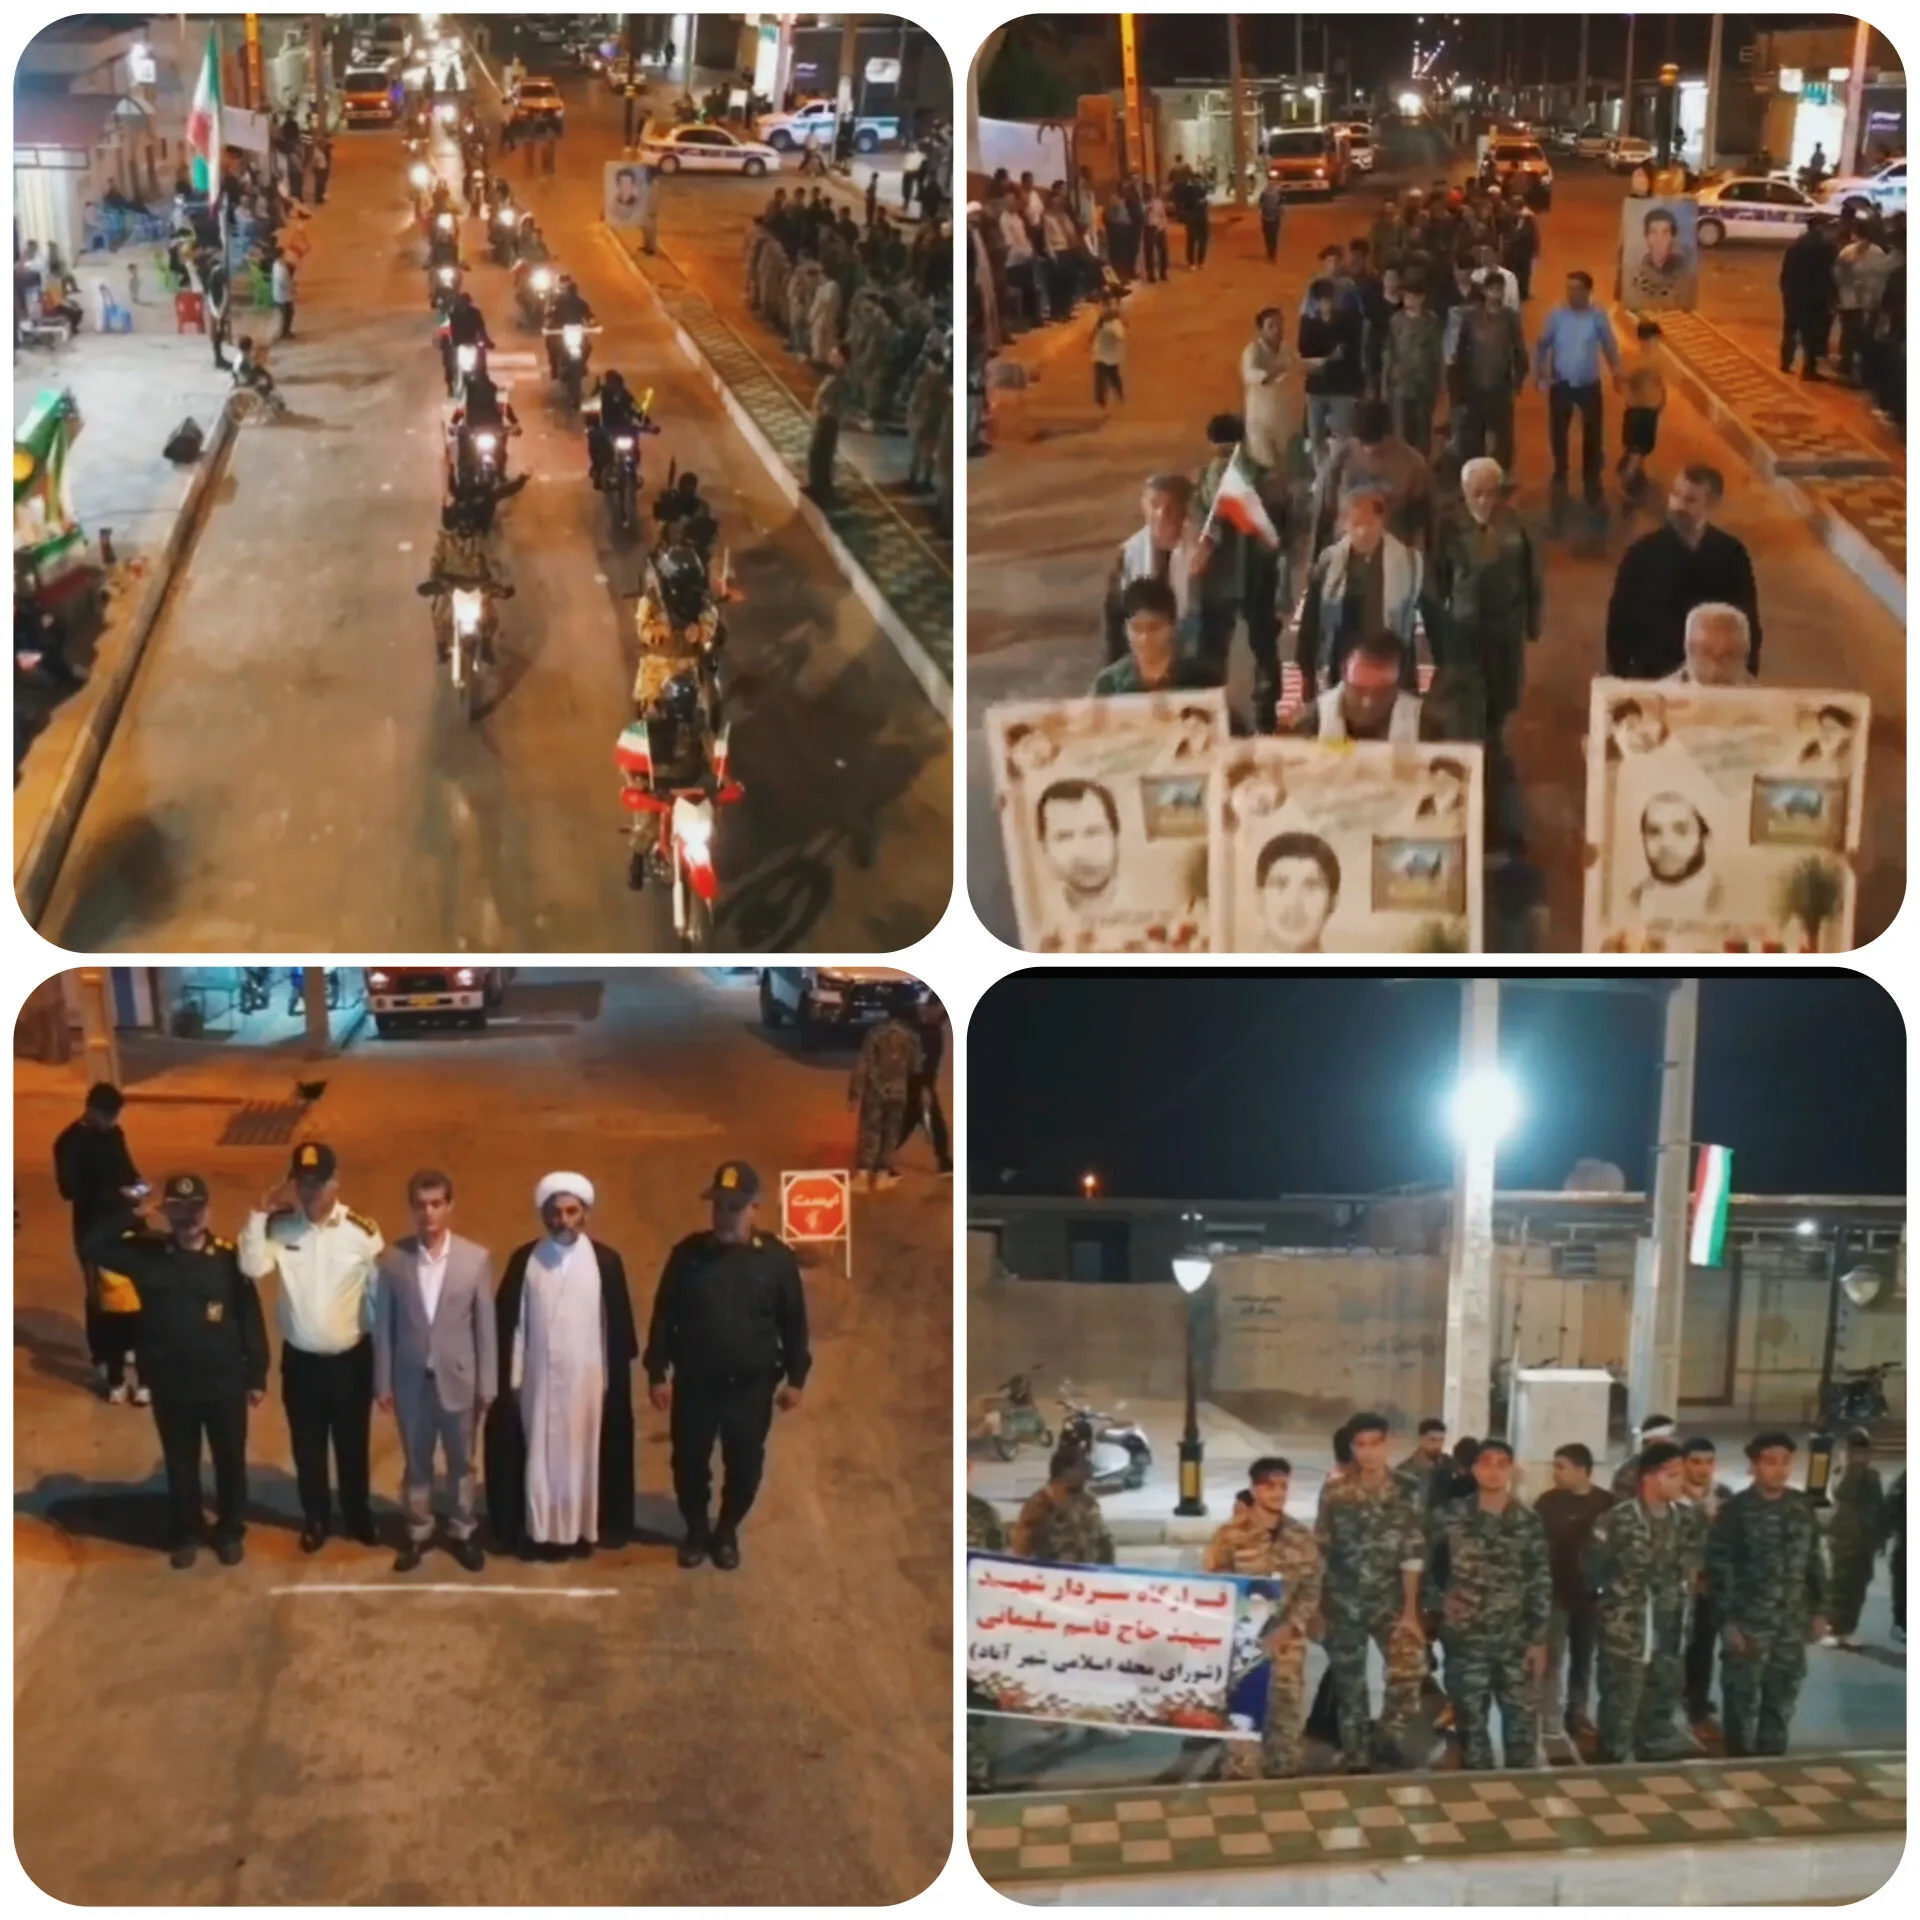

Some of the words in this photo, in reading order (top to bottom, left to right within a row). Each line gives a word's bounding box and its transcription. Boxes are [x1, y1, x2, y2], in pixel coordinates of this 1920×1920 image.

[976, 1571, 1046, 1595] شهید
[1051, 1577, 1130, 1605] سردار
[975, 1604, 1057, 1633] سلیمانی
[1062, 1614, 1111, 1638] قاسم
[1116, 1619, 1159, 1645] حاج
[1052, 1653, 1112, 1673] اسلامی
